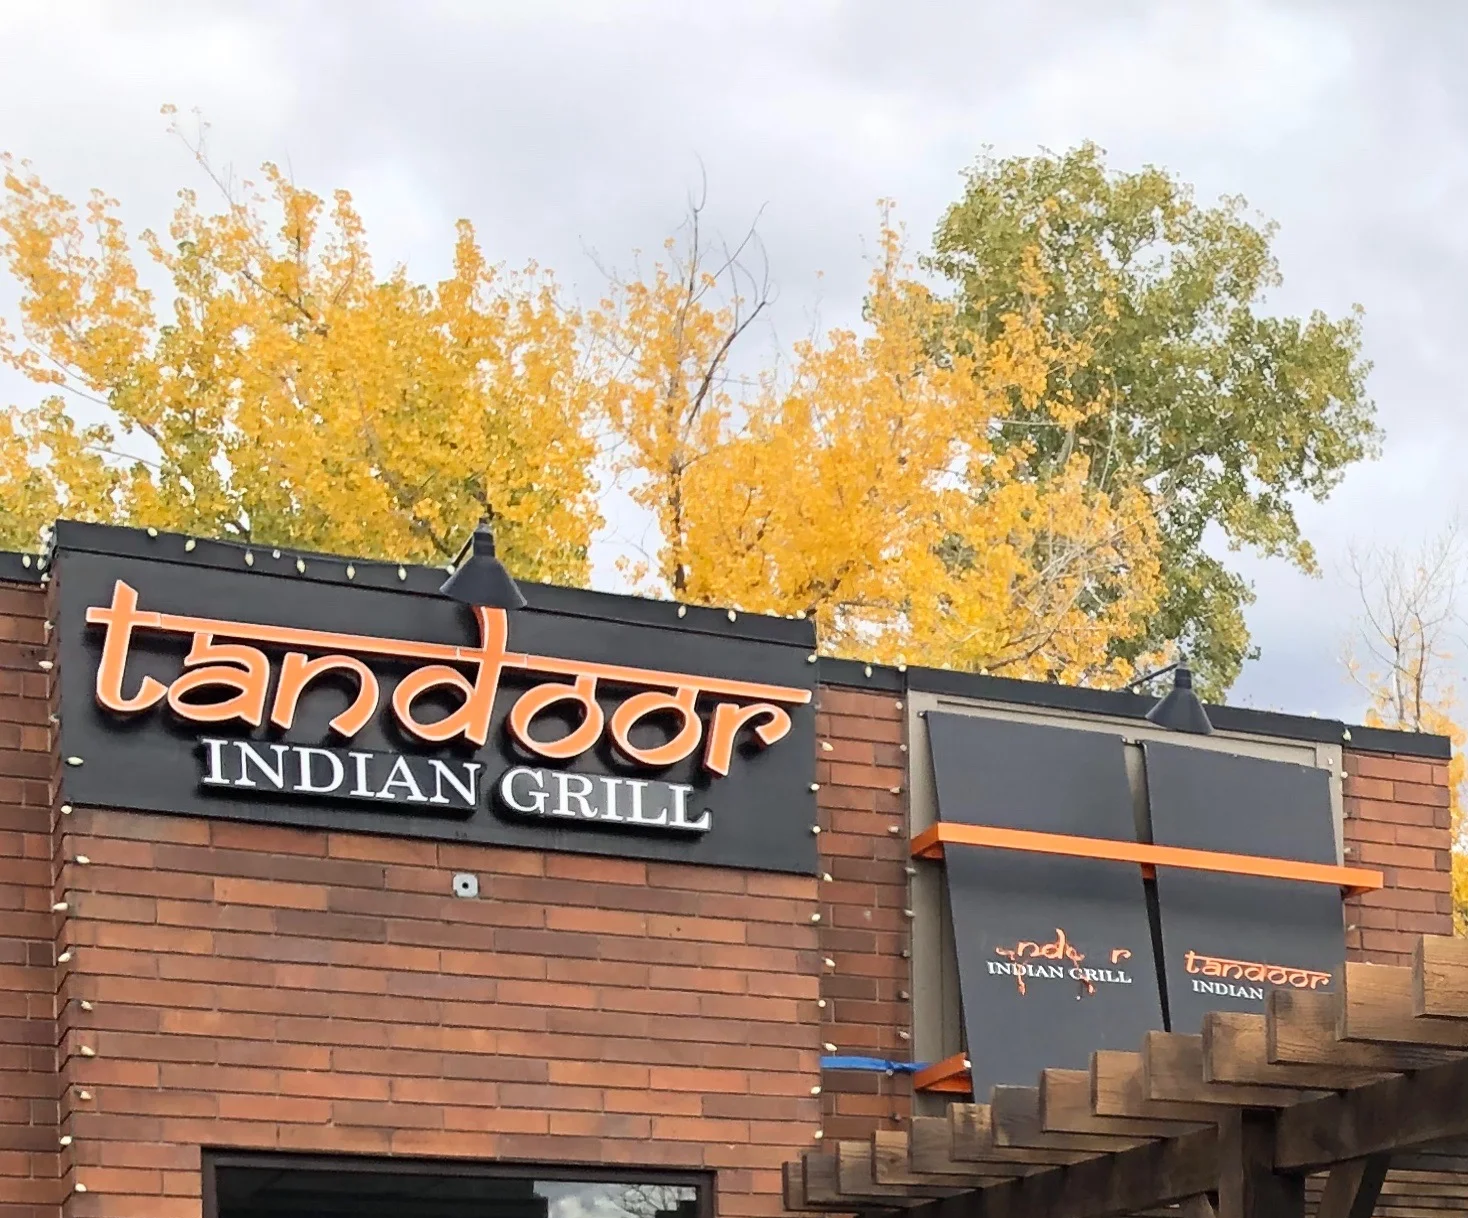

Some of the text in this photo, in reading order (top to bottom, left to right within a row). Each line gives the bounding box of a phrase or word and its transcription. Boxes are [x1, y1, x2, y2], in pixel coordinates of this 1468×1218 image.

[86, 579, 812, 779] tandoor
[201, 737, 711, 832] INDIAN GRILL
[987, 961, 1132, 984] INDIAN GRILL
[1192, 979, 1264, 1000] INDIAN
